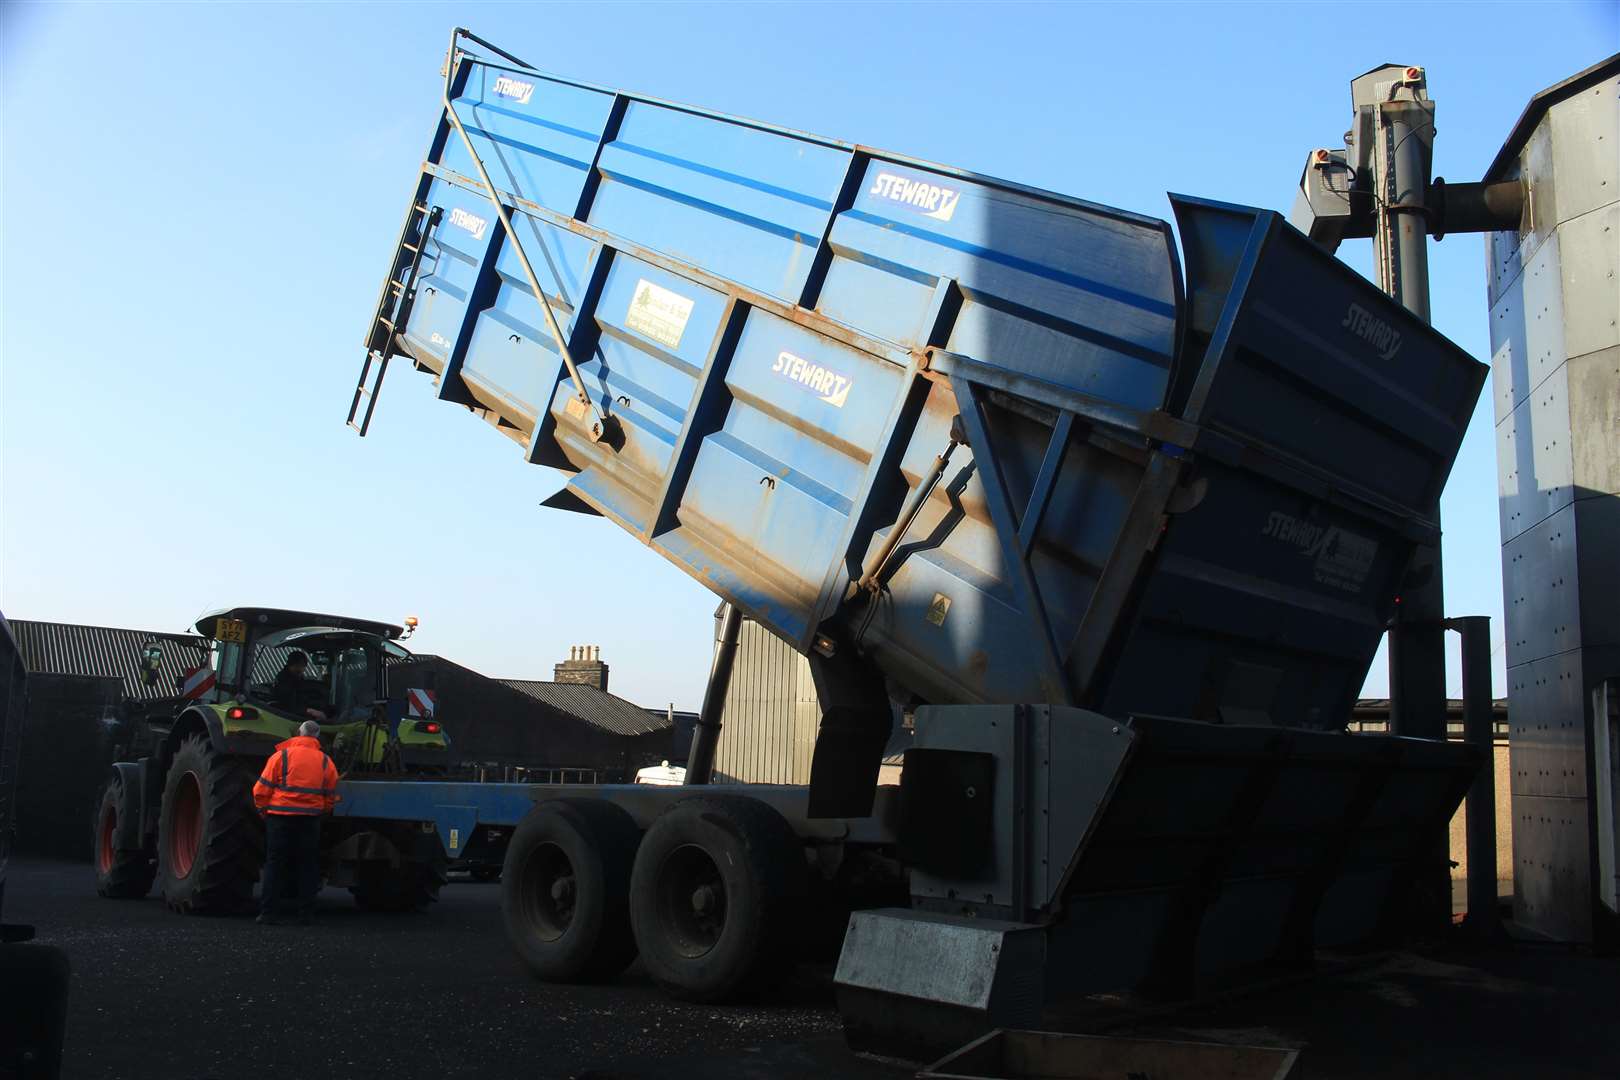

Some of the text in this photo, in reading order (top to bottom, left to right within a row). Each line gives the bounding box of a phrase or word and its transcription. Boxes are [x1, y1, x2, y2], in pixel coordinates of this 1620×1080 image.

[493, 78, 533, 104] STEWART
[872, 174, 960, 222] STEWART
[450, 208, 487, 240] STEWART
[1342, 303, 1401, 360] STEWART
[773, 352, 852, 408] STEWART
[1261, 511, 1325, 556] STEWART
